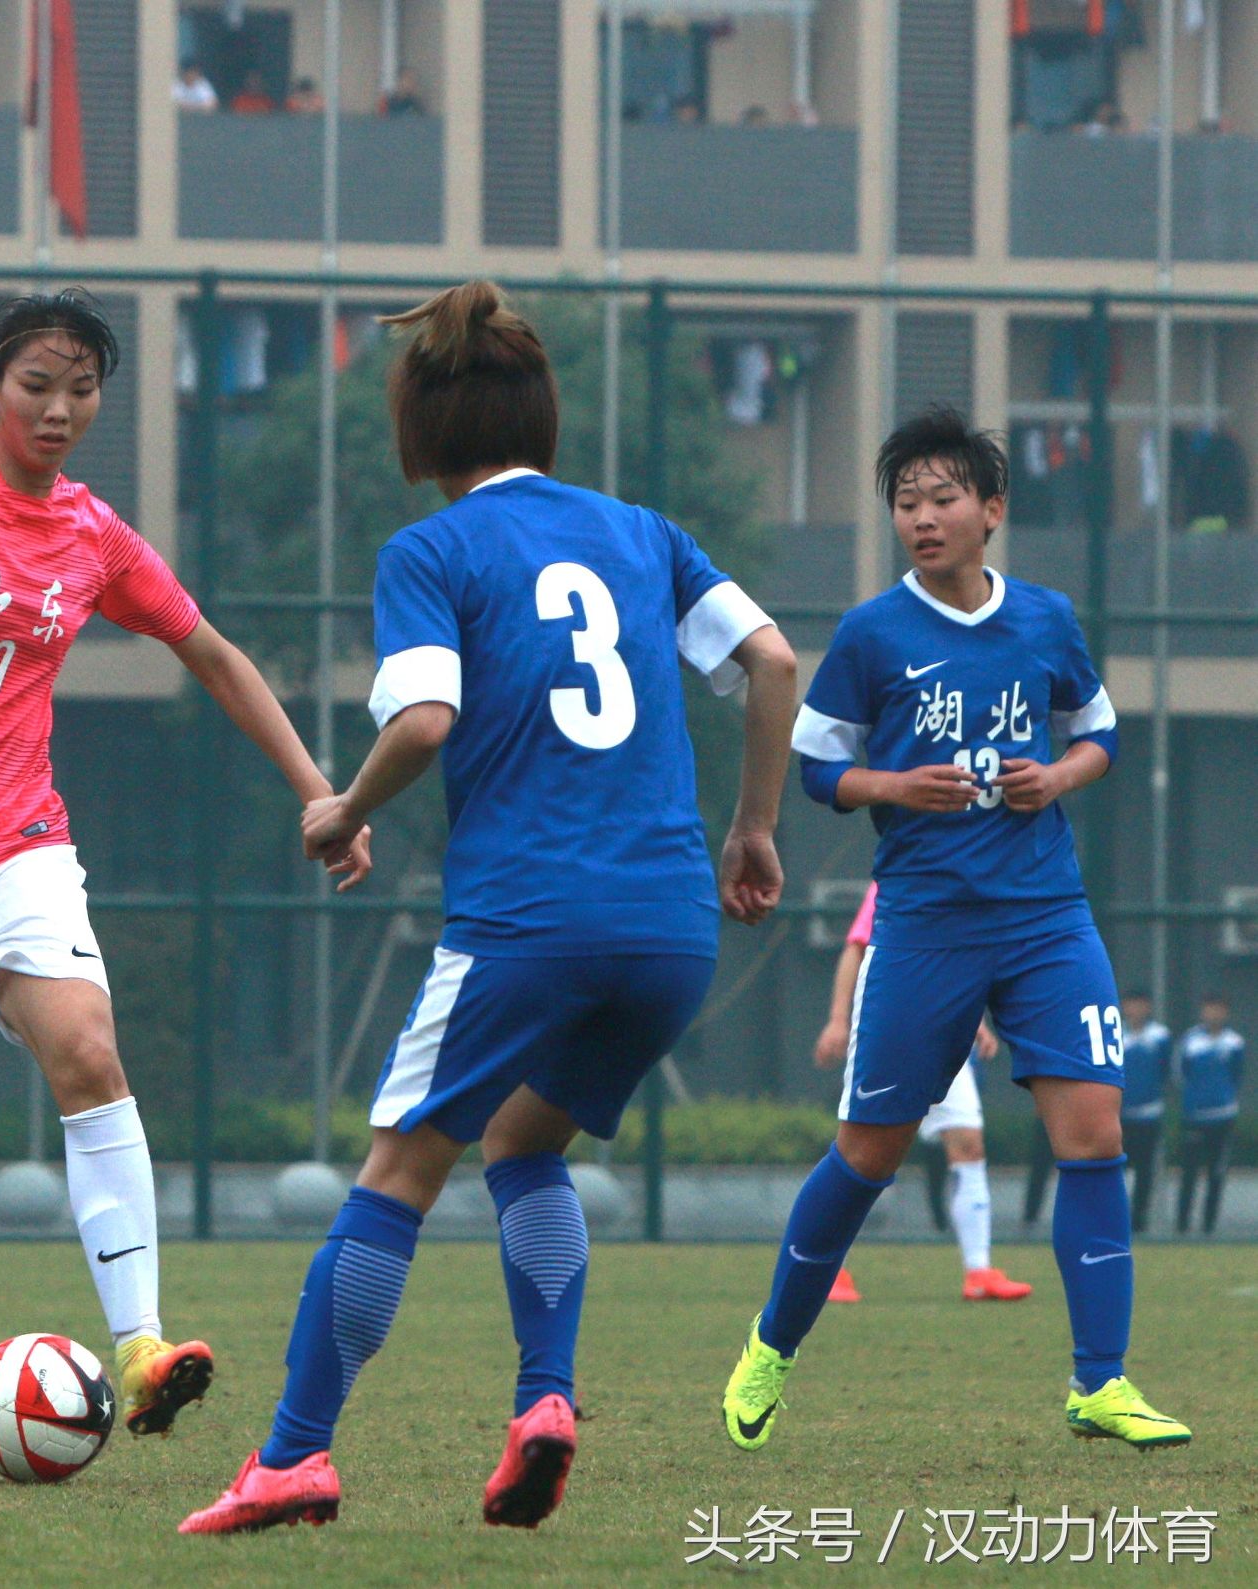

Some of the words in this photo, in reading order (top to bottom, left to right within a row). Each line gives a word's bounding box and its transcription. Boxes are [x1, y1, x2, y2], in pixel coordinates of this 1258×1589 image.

[535, 561, 637, 750] 3
[914, 681, 1032, 742] 湖北
[953, 747, 1003, 811] 13
[1080, 1004, 1124, 1067] 13
